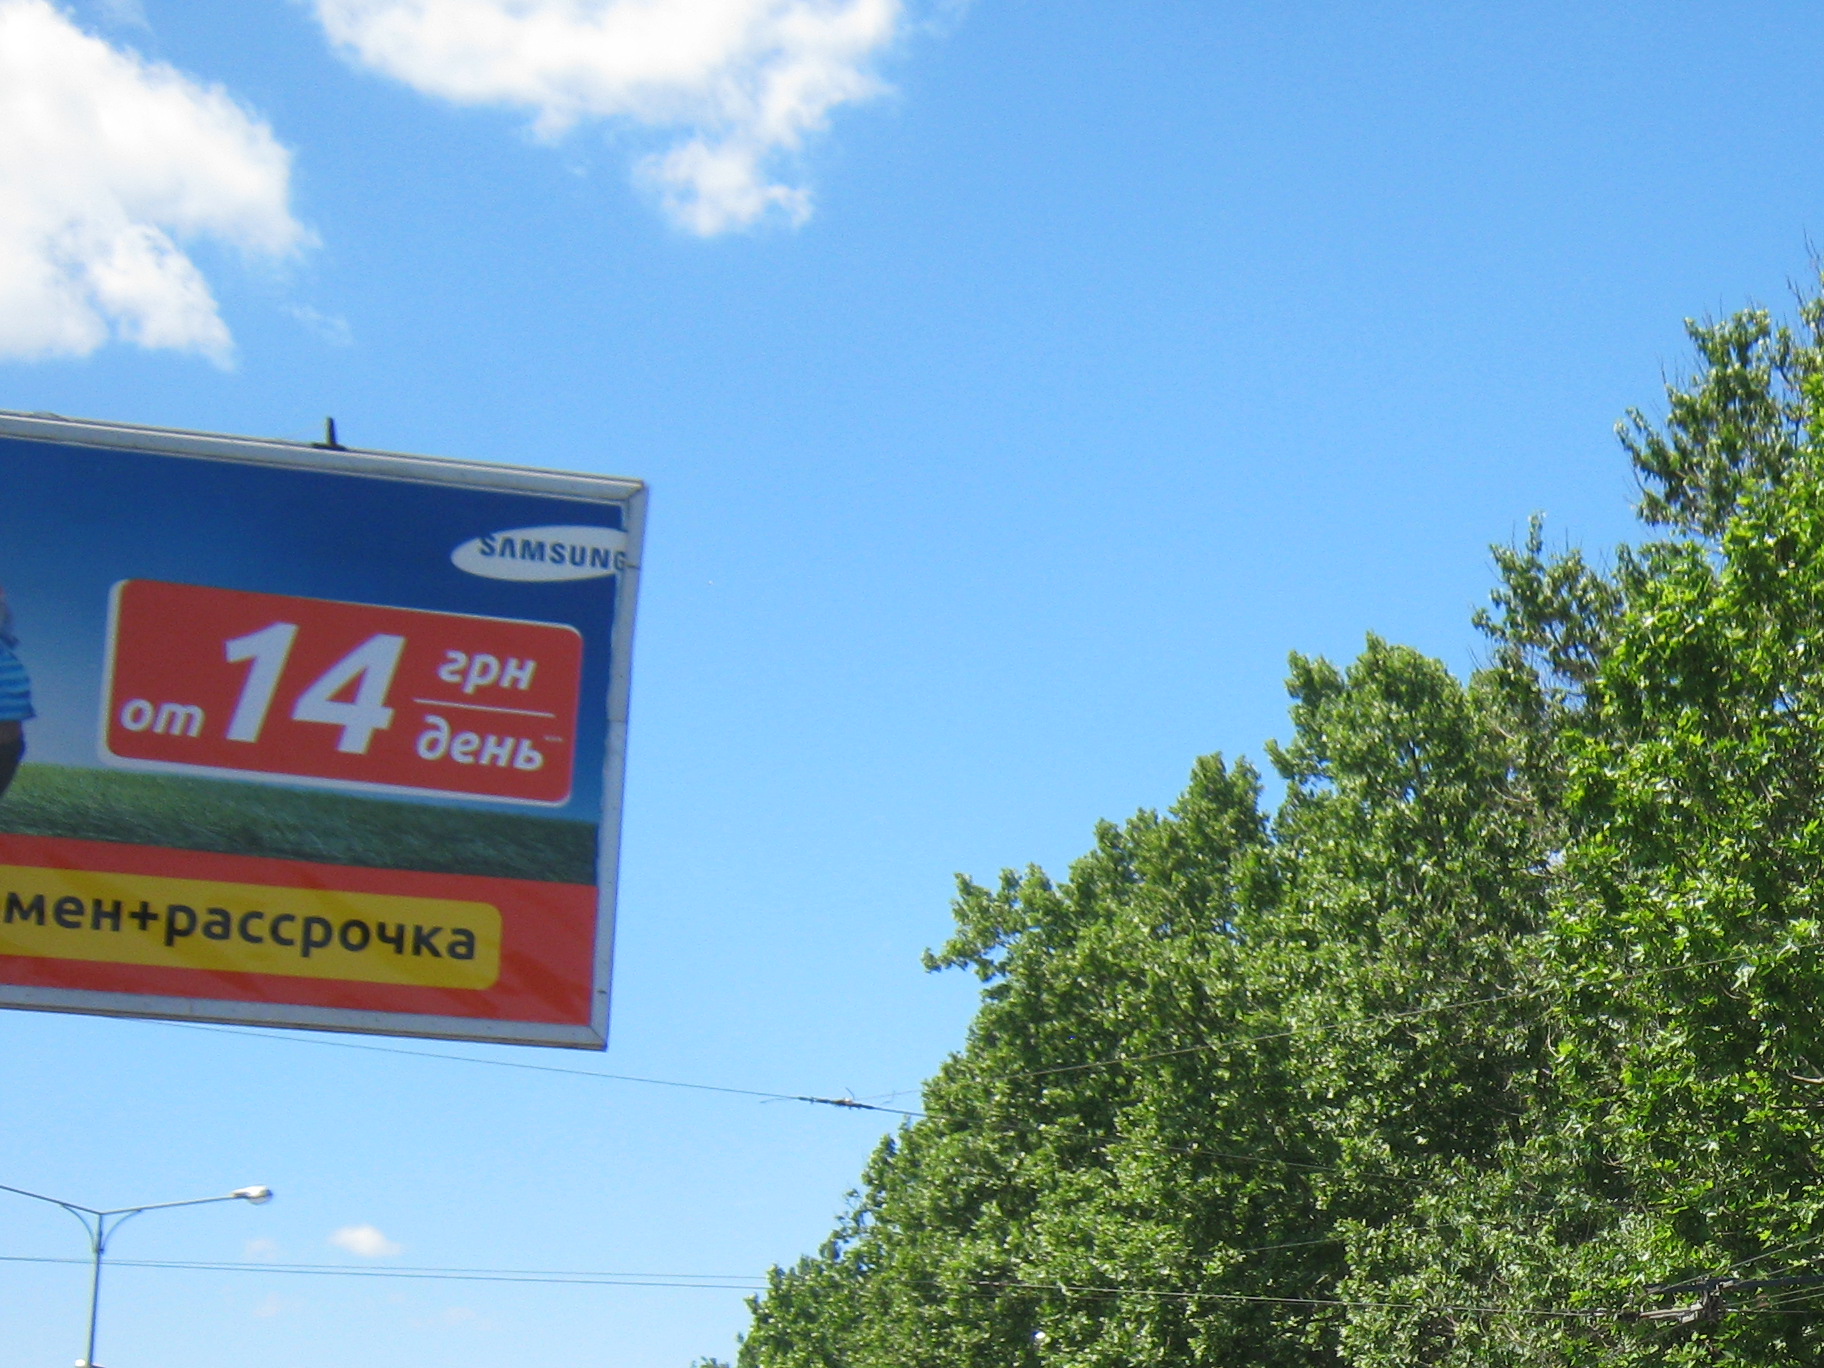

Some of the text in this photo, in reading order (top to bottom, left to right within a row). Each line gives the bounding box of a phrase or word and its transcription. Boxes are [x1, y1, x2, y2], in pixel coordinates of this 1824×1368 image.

[479, 532, 627, 571] SAMSUNG
[120, 620, 406, 755] от 14
[437, 648, 536, 695] грн
[416, 714, 545, 771] день
